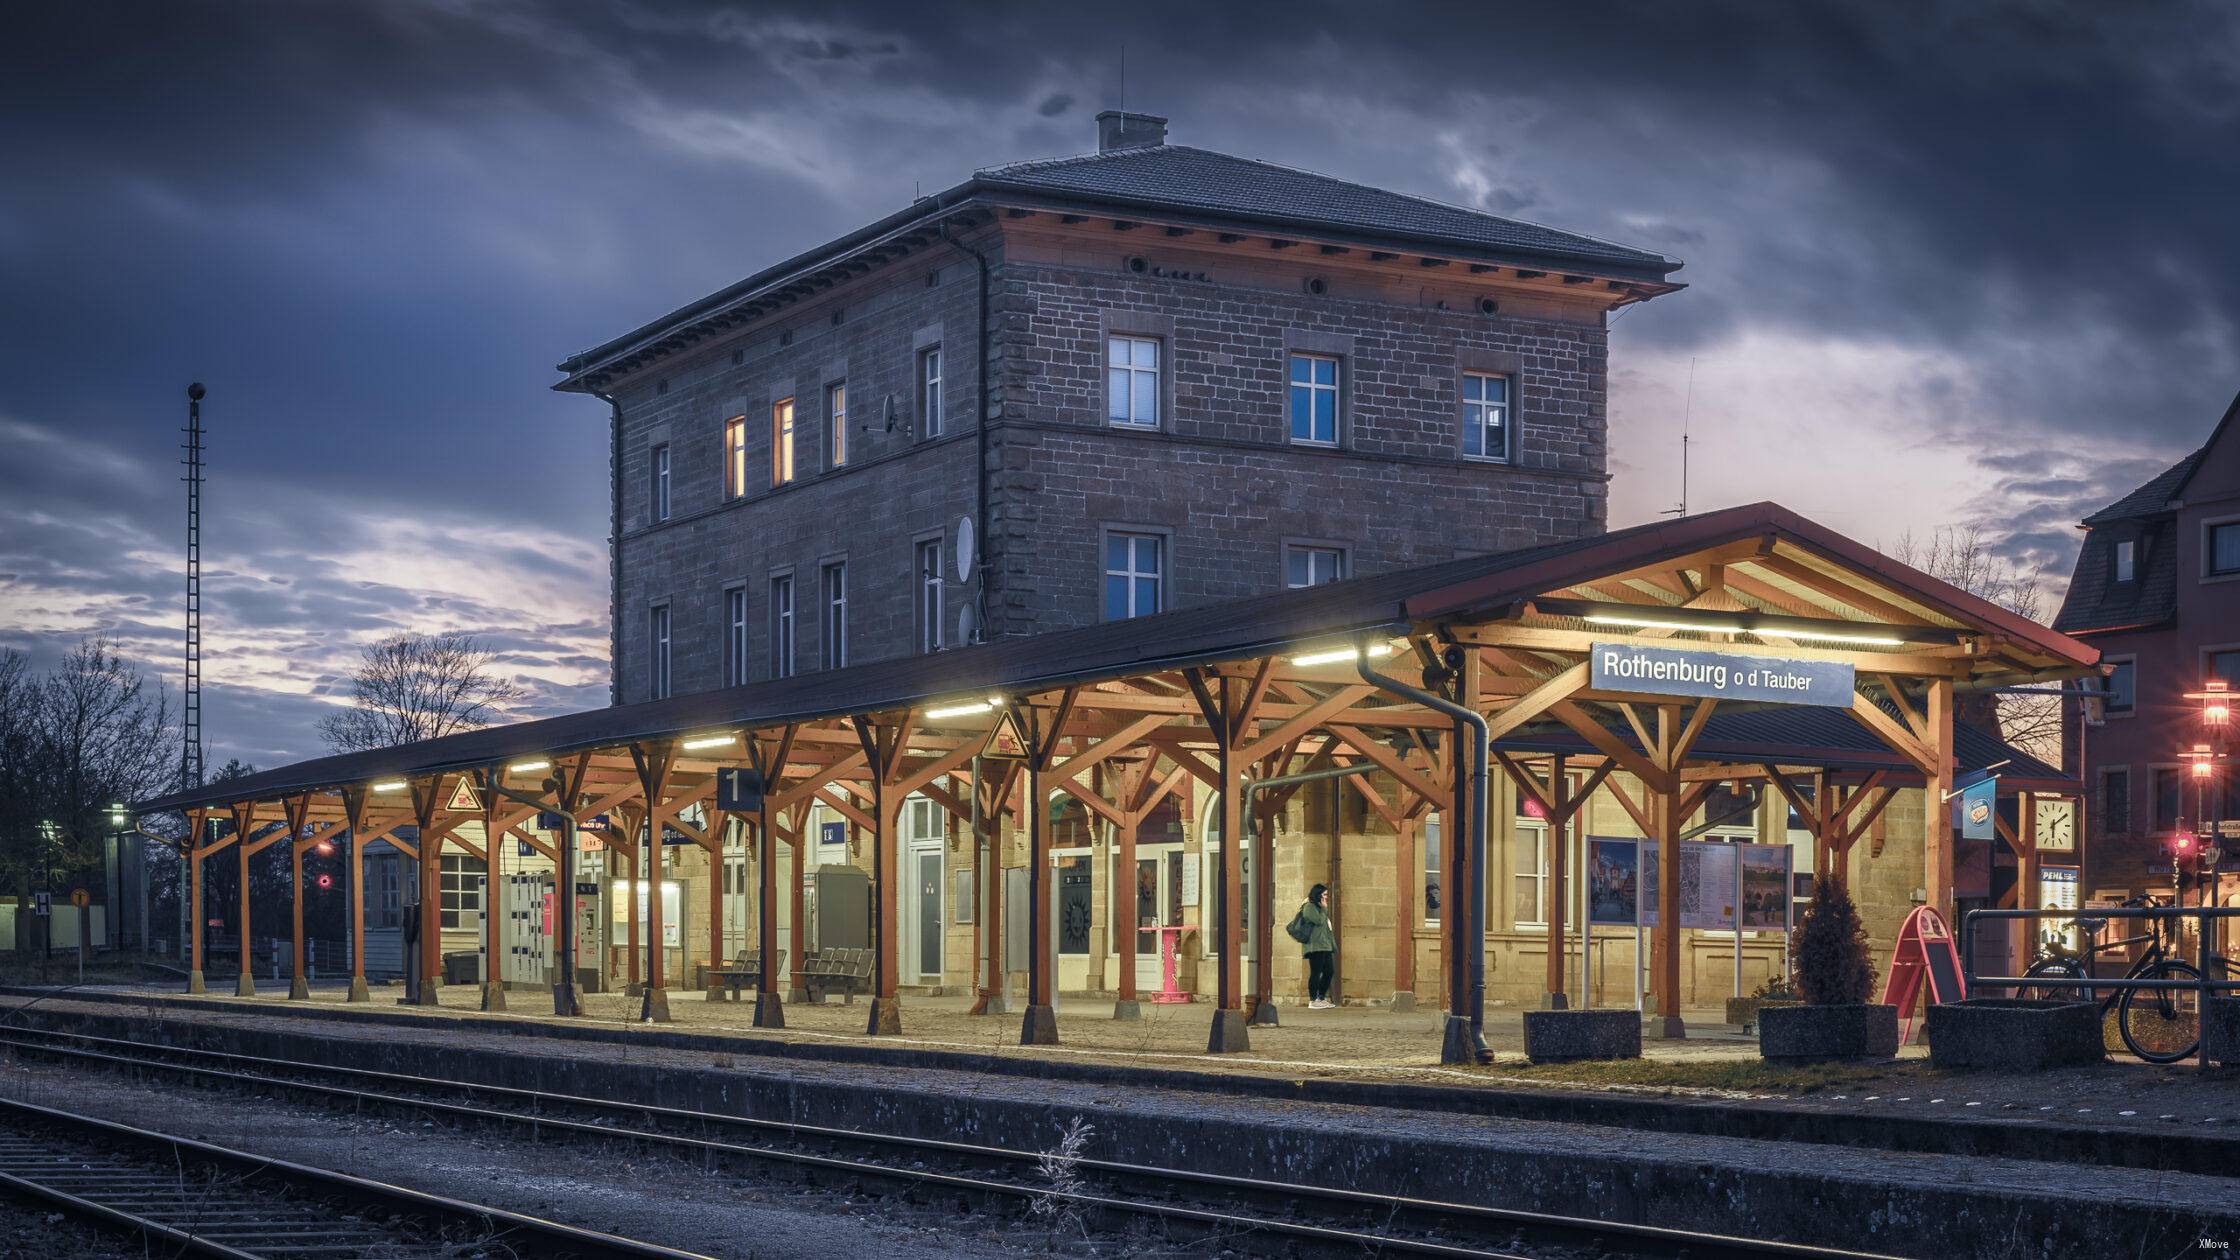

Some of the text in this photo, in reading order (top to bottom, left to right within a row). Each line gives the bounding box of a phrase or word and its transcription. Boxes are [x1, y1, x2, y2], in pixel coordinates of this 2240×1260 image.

[1604, 651, 1813, 690] Rothenburg o d Tauber
[726, 770, 739, 802] 1
[36, 894, 50, 913] H
